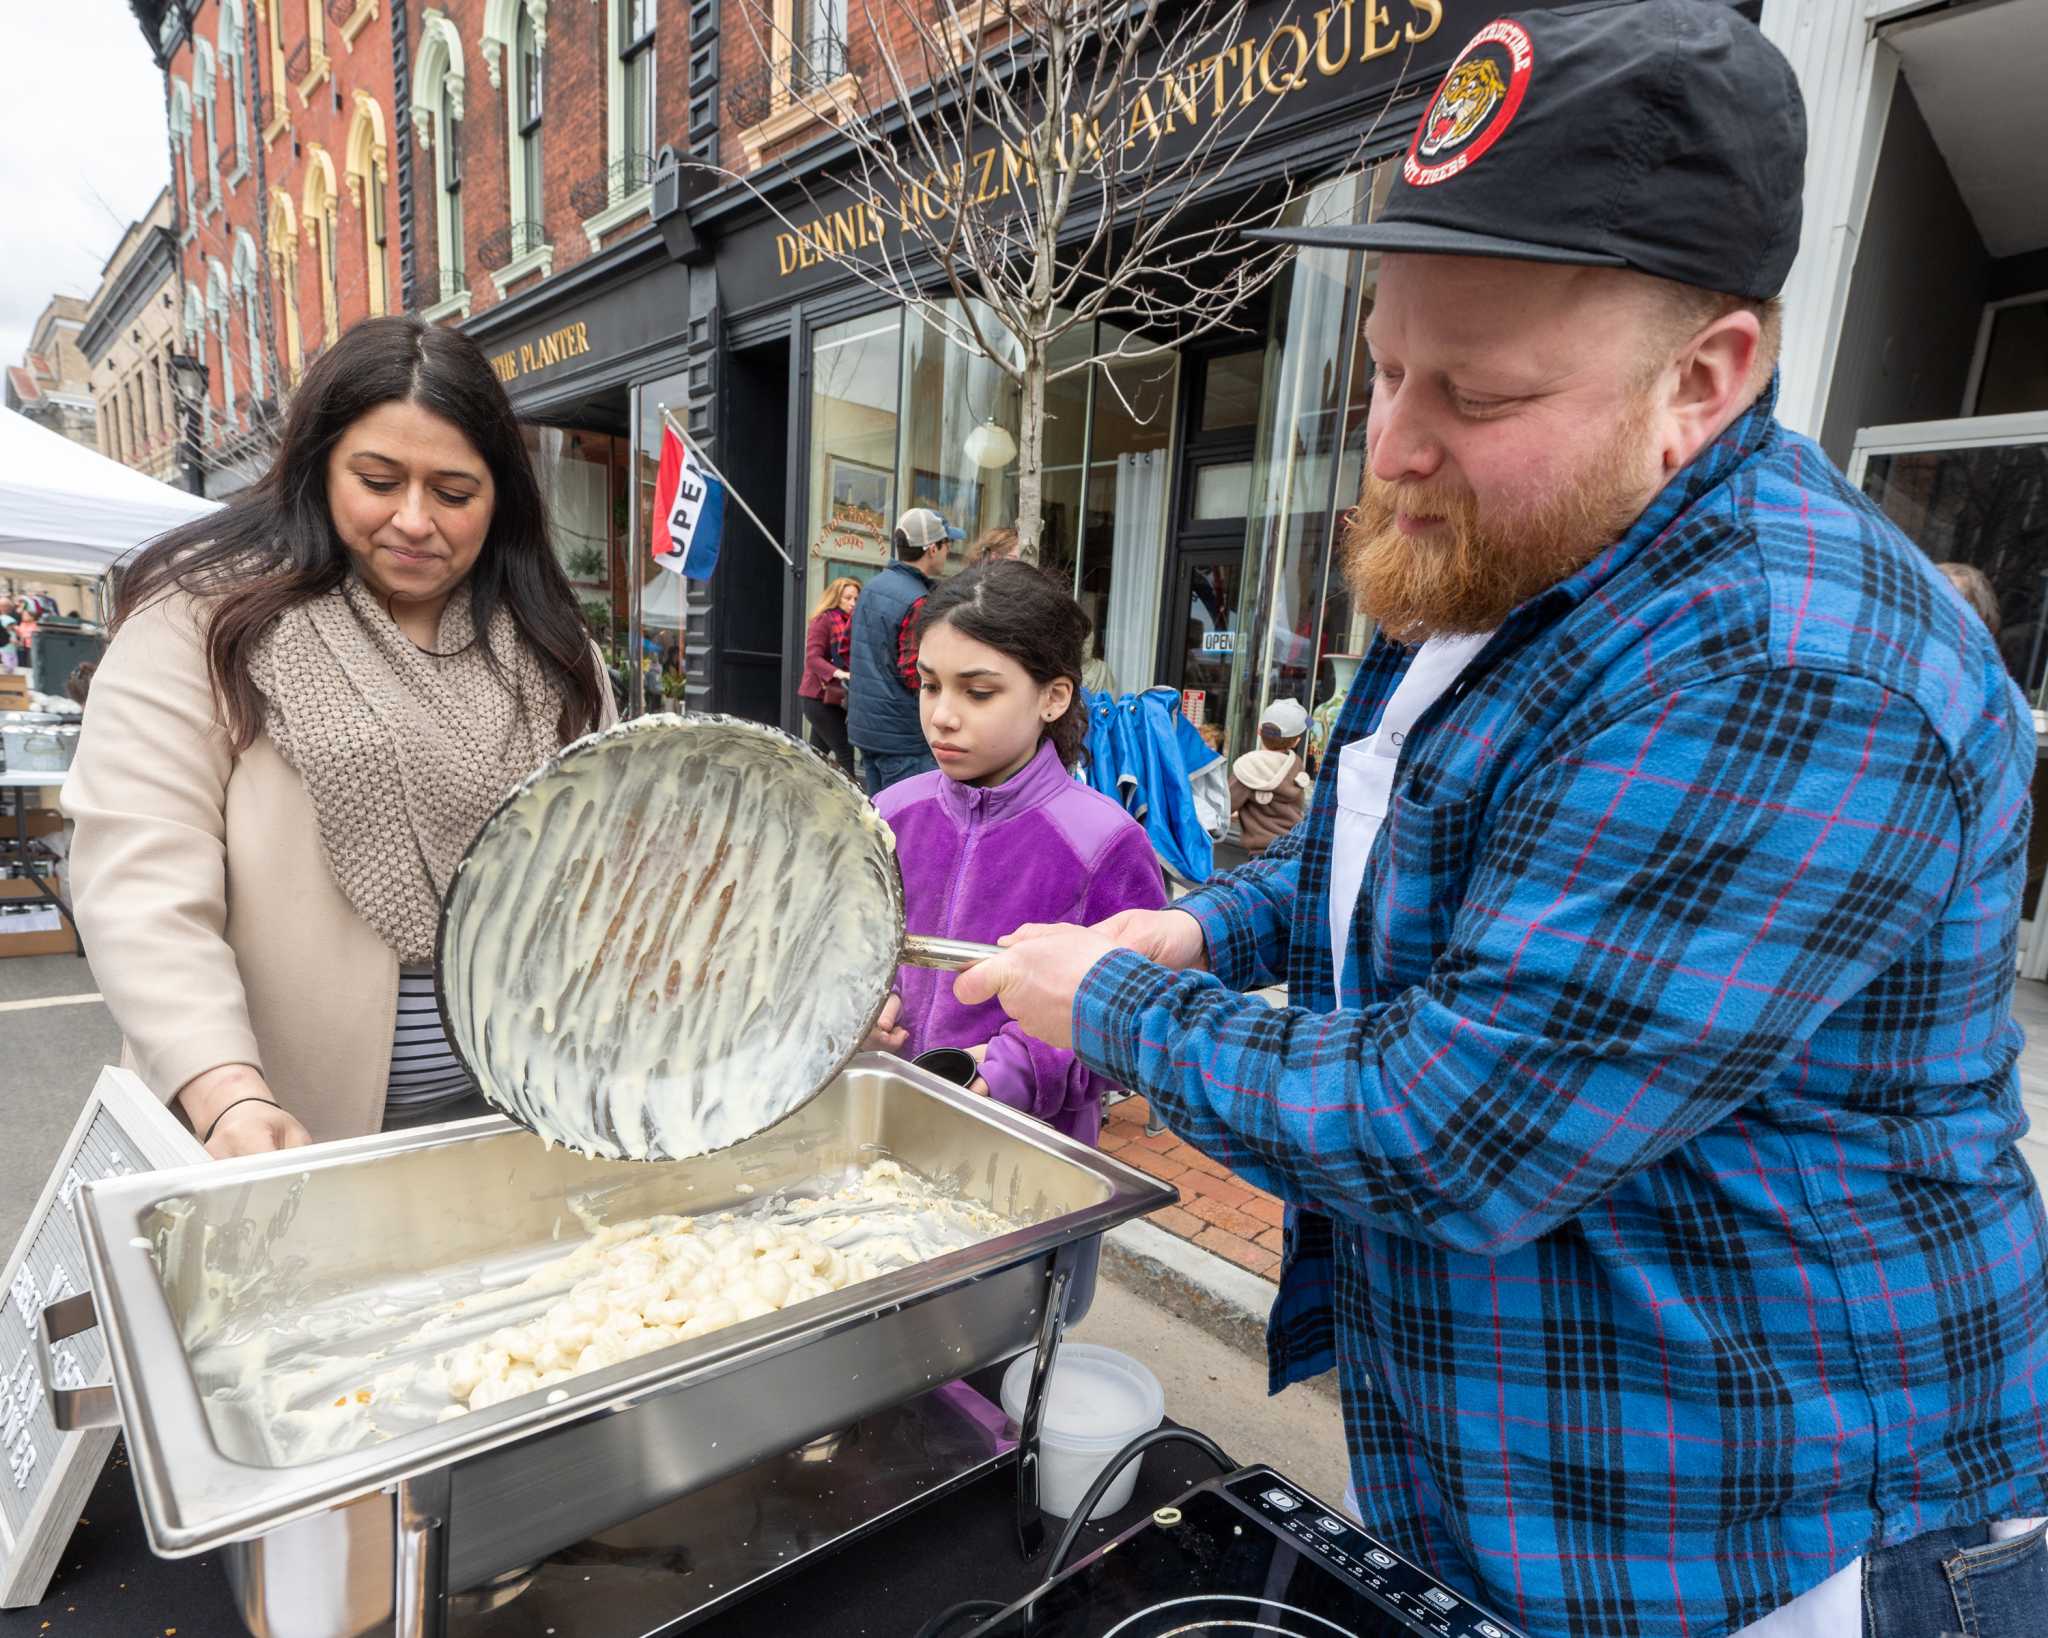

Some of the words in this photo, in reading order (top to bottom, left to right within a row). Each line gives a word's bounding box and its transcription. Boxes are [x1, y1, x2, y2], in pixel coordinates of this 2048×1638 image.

[776, 195, 885, 276] DENNIS
[1124, 0, 1444, 149] ANTIQUES
[1416, 154, 1468, 185] TIGERS
[490, 350, 519, 382] THE
[520, 321, 590, 374] PLANTER
[1205, 633, 1233, 650] OPEN
